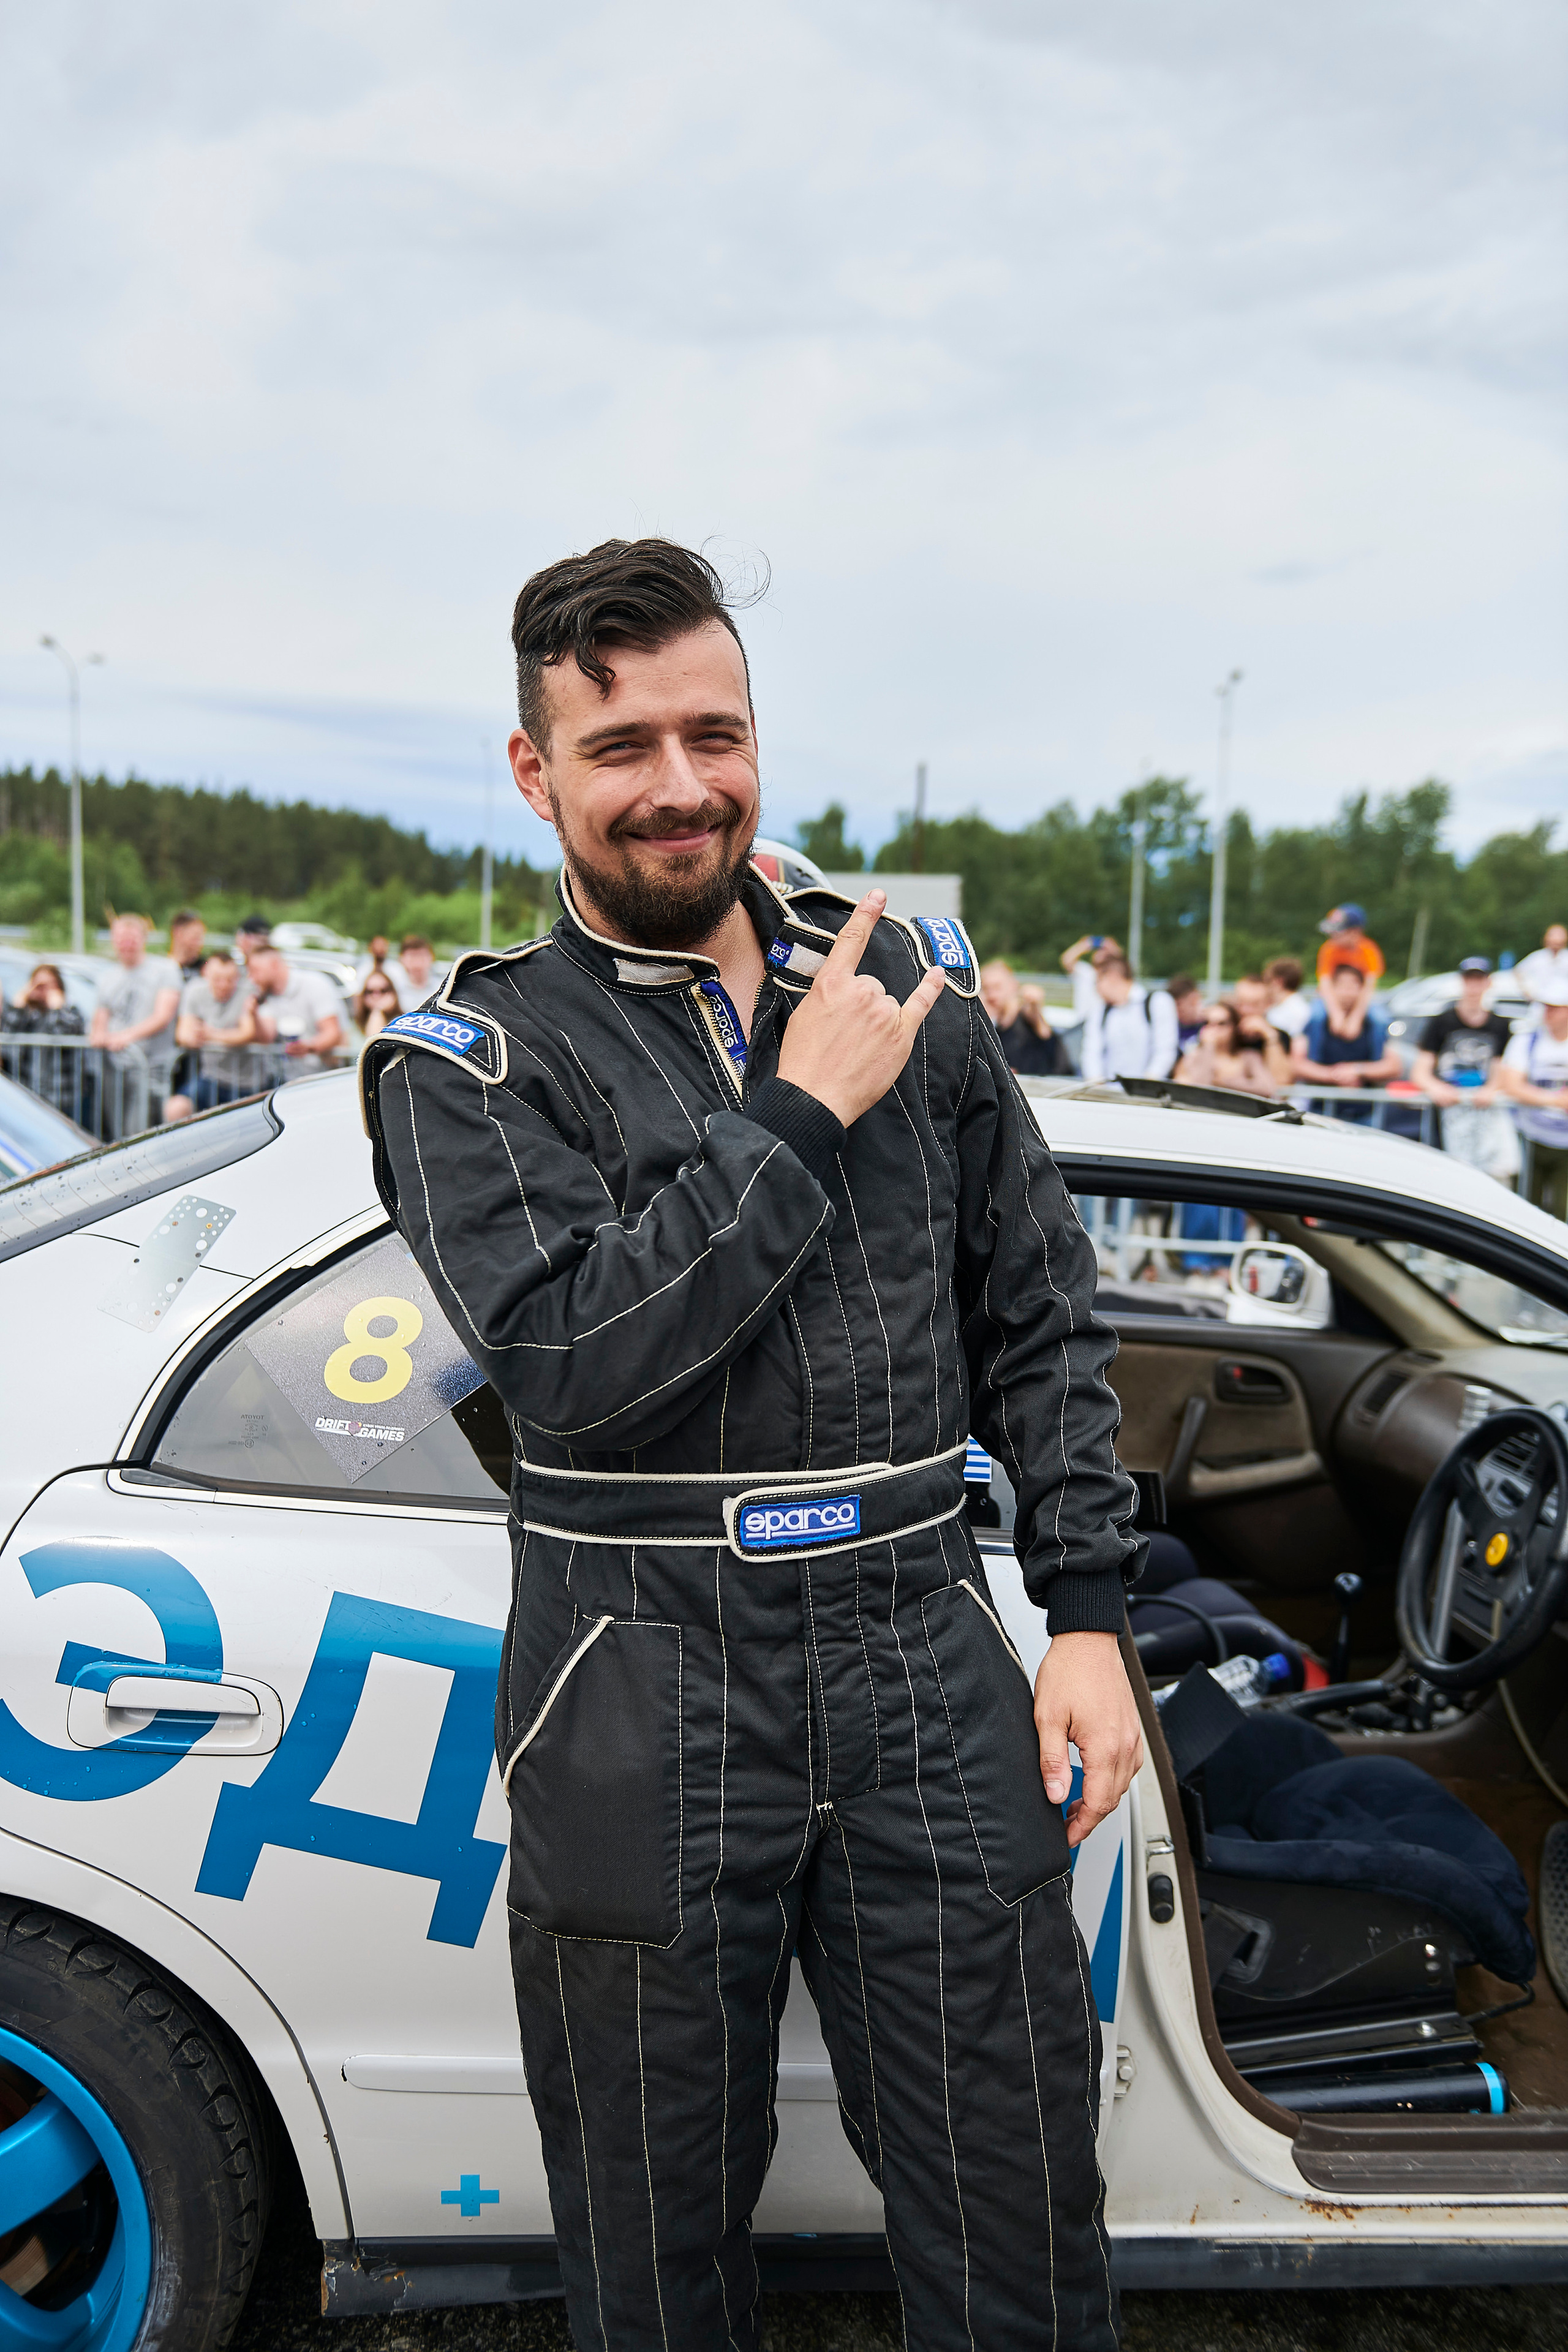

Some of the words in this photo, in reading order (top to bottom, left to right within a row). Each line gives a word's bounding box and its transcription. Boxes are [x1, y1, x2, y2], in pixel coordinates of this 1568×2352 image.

[395, 1015, 475, 1044] sparco
[709, 995, 736, 1048] sparco
[324, 1296, 423, 1404] 8
[315, 1417, 352, 1430] DRIFT
[360, 1428, 405, 1441] GAMES
[745, 1503, 855, 1540] sparco
